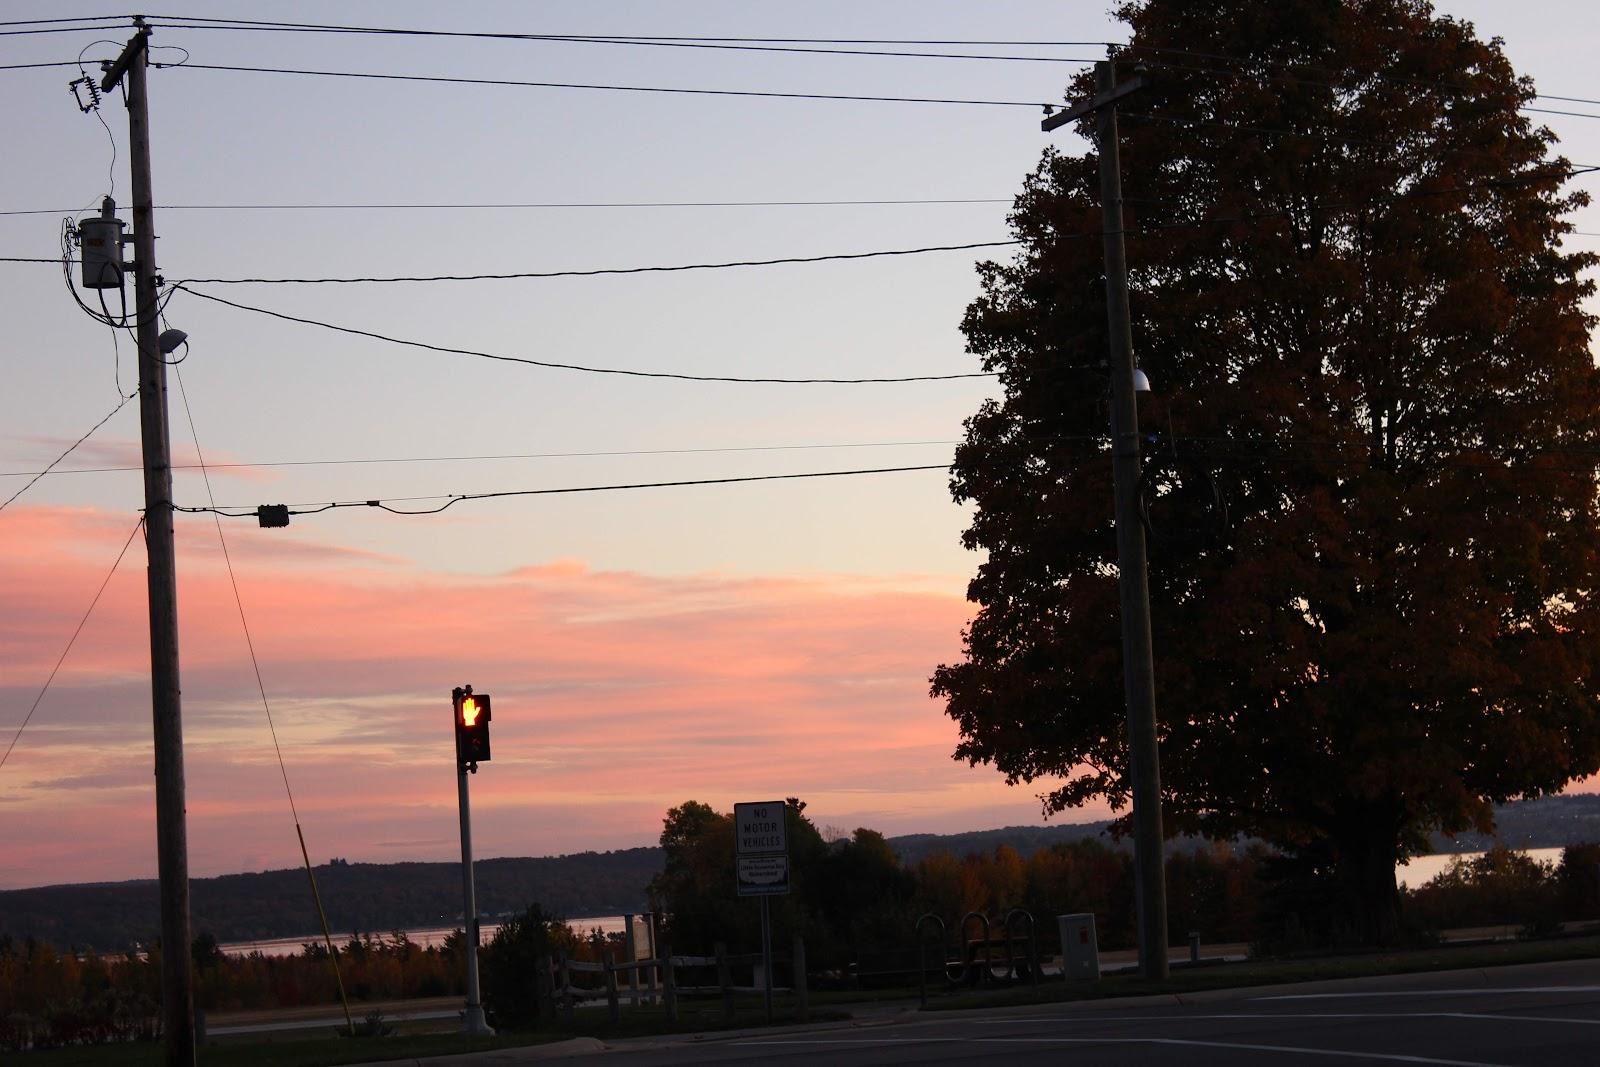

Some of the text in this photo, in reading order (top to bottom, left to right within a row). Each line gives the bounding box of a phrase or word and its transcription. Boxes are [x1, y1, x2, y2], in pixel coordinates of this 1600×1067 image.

[753, 808, 767, 819] NO
[744, 822, 777, 834] MOTOR
[743, 836, 780, 848] VEHICLES
